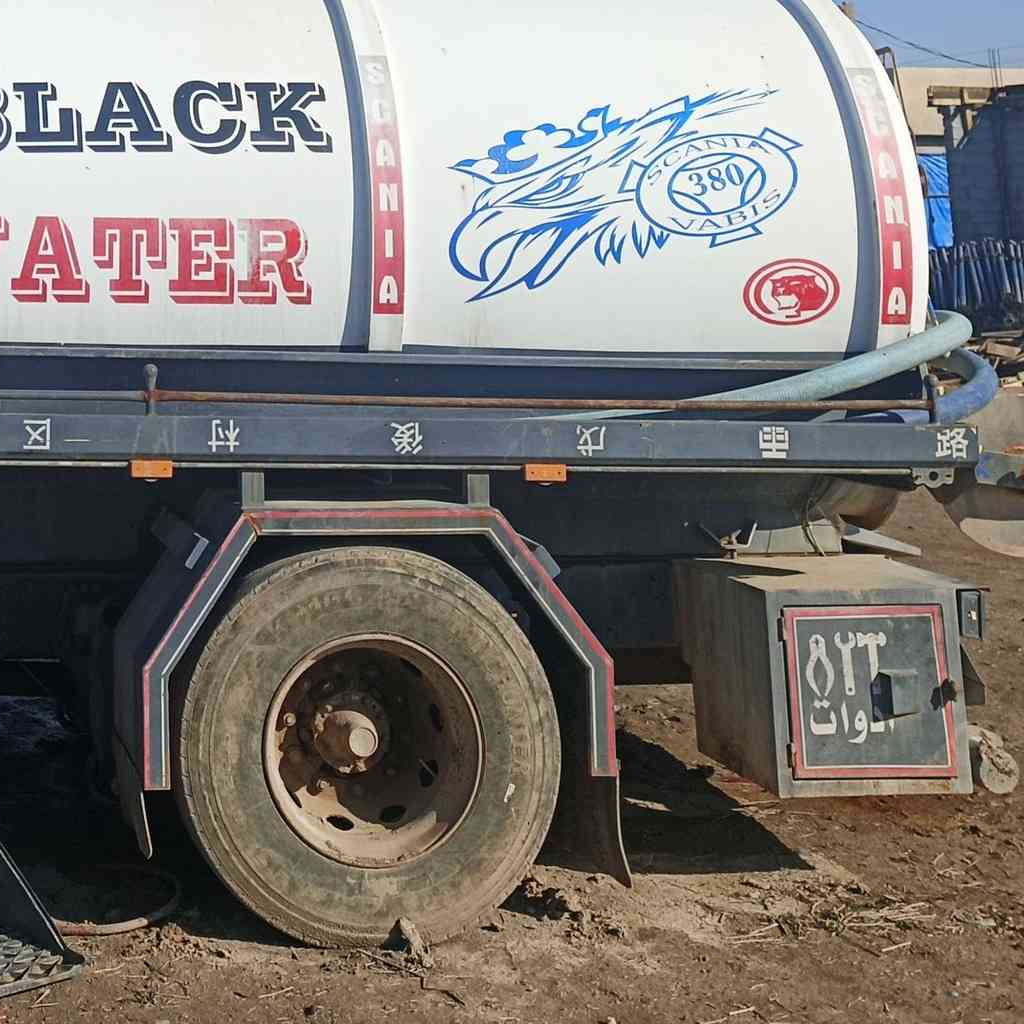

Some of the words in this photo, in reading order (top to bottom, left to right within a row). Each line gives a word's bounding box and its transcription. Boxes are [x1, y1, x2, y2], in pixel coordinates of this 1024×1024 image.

[647, 137, 772, 186] SCANIA
[688, 163, 745, 196] 380
[668, 188, 781, 231] VABIS
